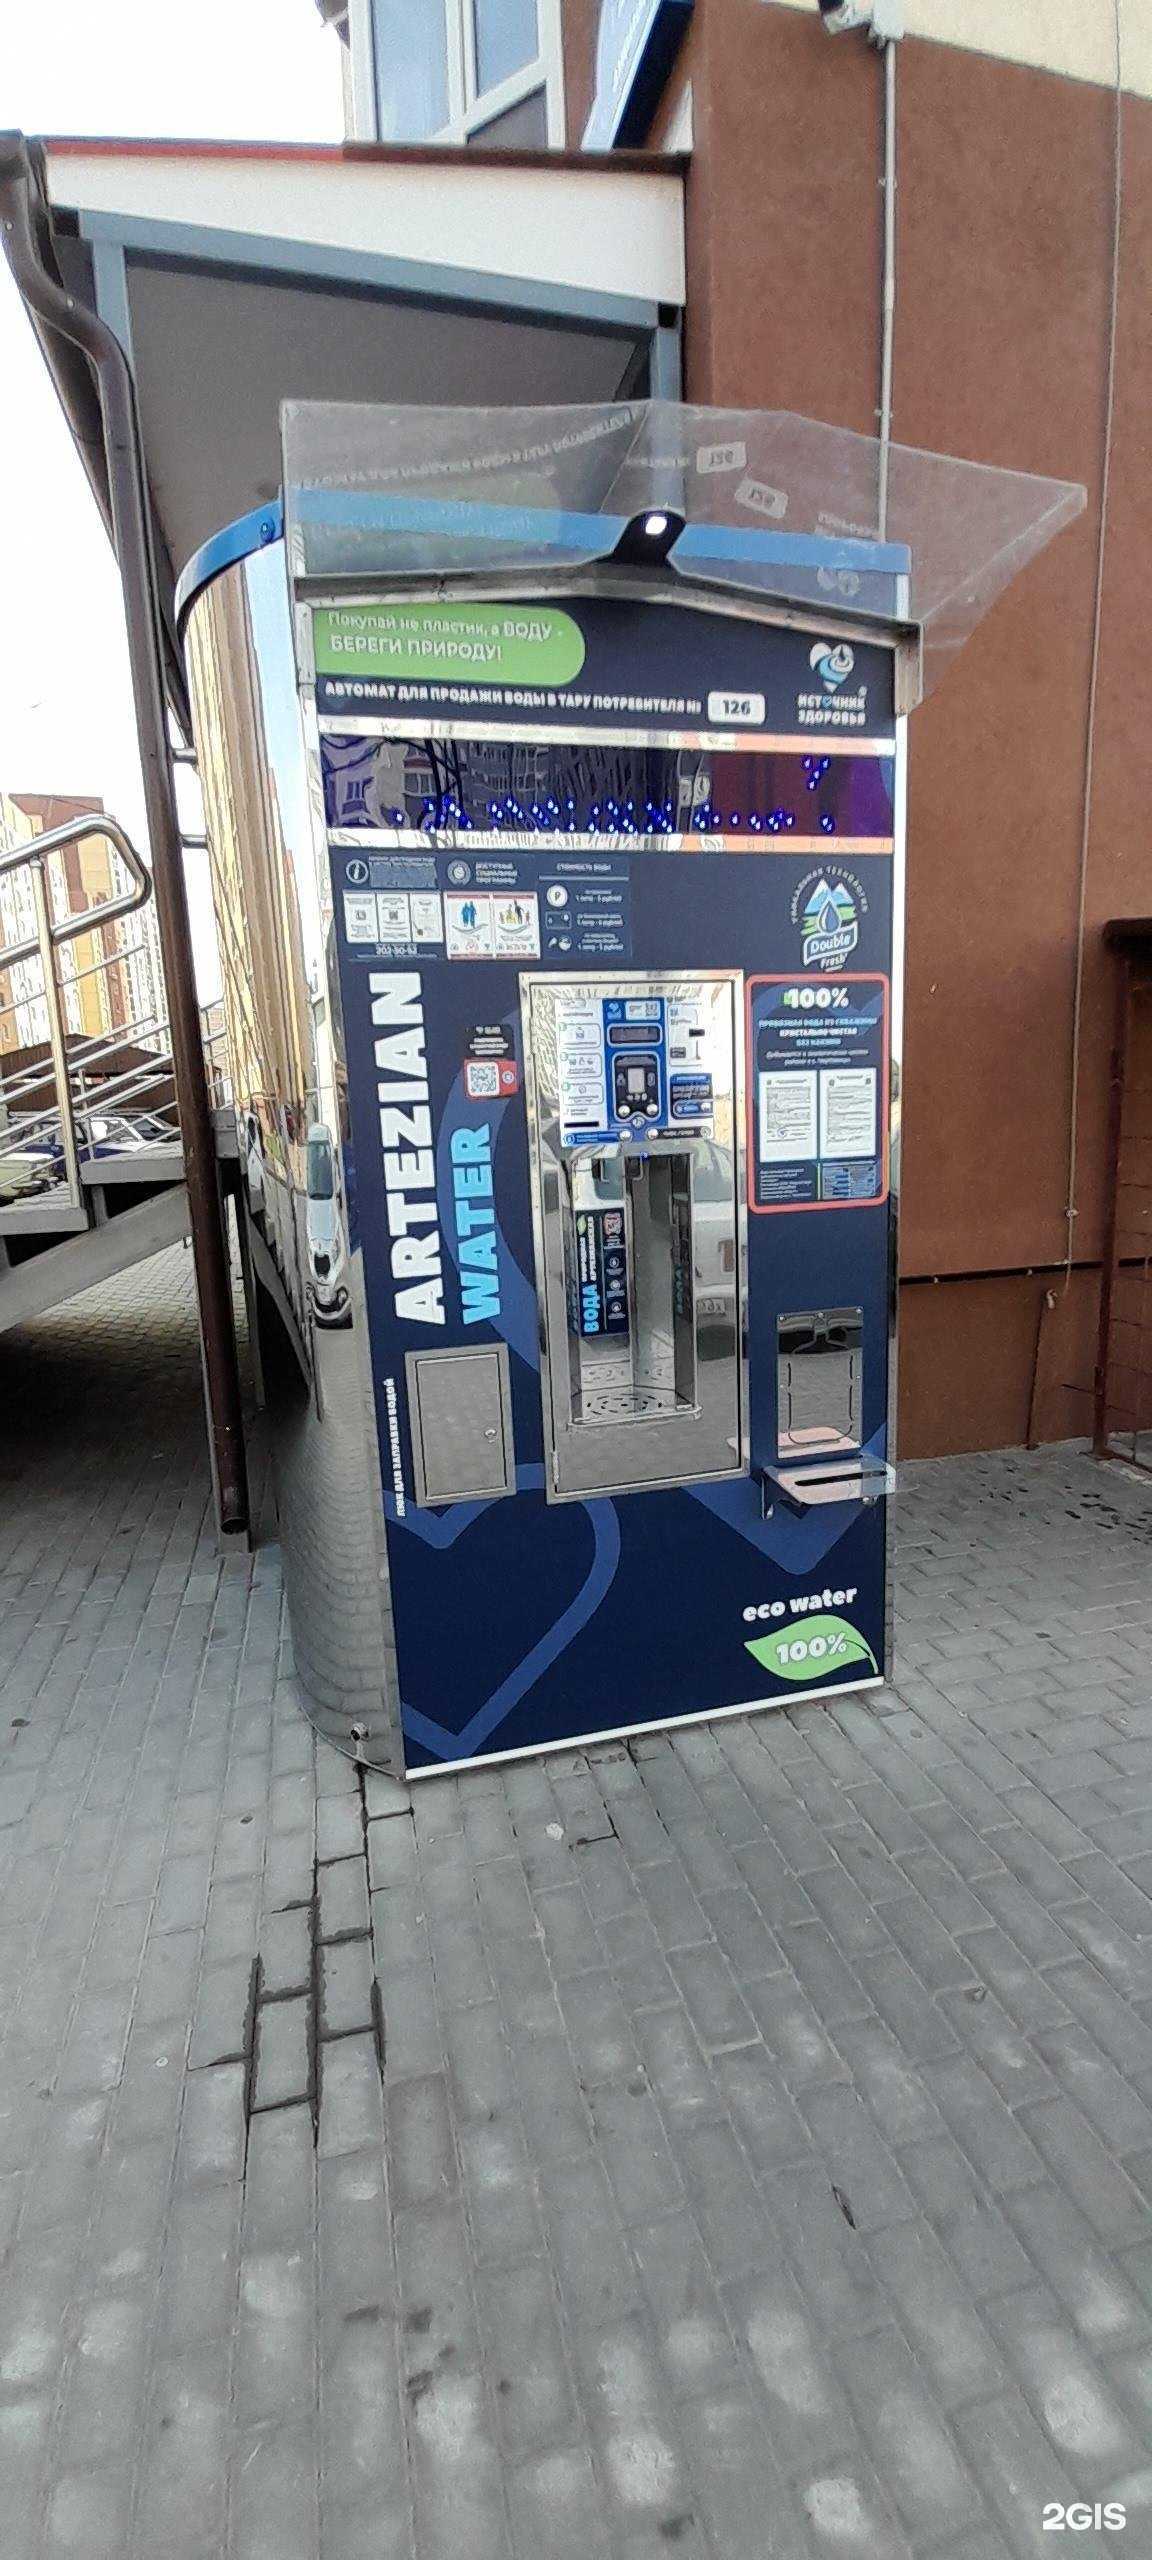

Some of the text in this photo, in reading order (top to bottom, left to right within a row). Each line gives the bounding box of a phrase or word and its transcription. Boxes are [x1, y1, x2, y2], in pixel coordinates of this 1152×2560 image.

[328, 611, 397, 631] Покупай
[400, 617, 418, 632] не
[503, 620, 552, 642] ВОДУ
[330, 634, 502, 661] БЕРЕГИ ПРИРОДУ!
[325, 681, 397, 699] АВТОМАТ
[398, 684, 429, 702] ДЛЯ
[430, 686, 502, 705] ПРОДАЖИ
[504, 690, 546, 707] ВОДЫ
[547, 692, 557, 706] В
[558, 693, 591, 711] ТАРУ
[593, 695, 685, 714] ПОТРЕБИТЕЛЯ
[722, 699, 750, 716] 126
[798, 694, 866, 711] ИСТОЧНИК
[798, 710, 866, 727] ЗДОРОВЬЯ
[810, 933, 851, 955] Double
[788, 986, 850, 1009] 100%
[369, 972, 446, 1325] ARTEZIAN
[450, 1122, 500, 1325] WATER
[578, 1283, 600, 1334] ВОДА
[382, 1378, 406, 1517] ЛЮК ДЛЯ ЗАПРАВКИ ВОДОЙ
[742, 1587, 858, 1622] eco water
[776, 1632, 848, 1665] 100%
